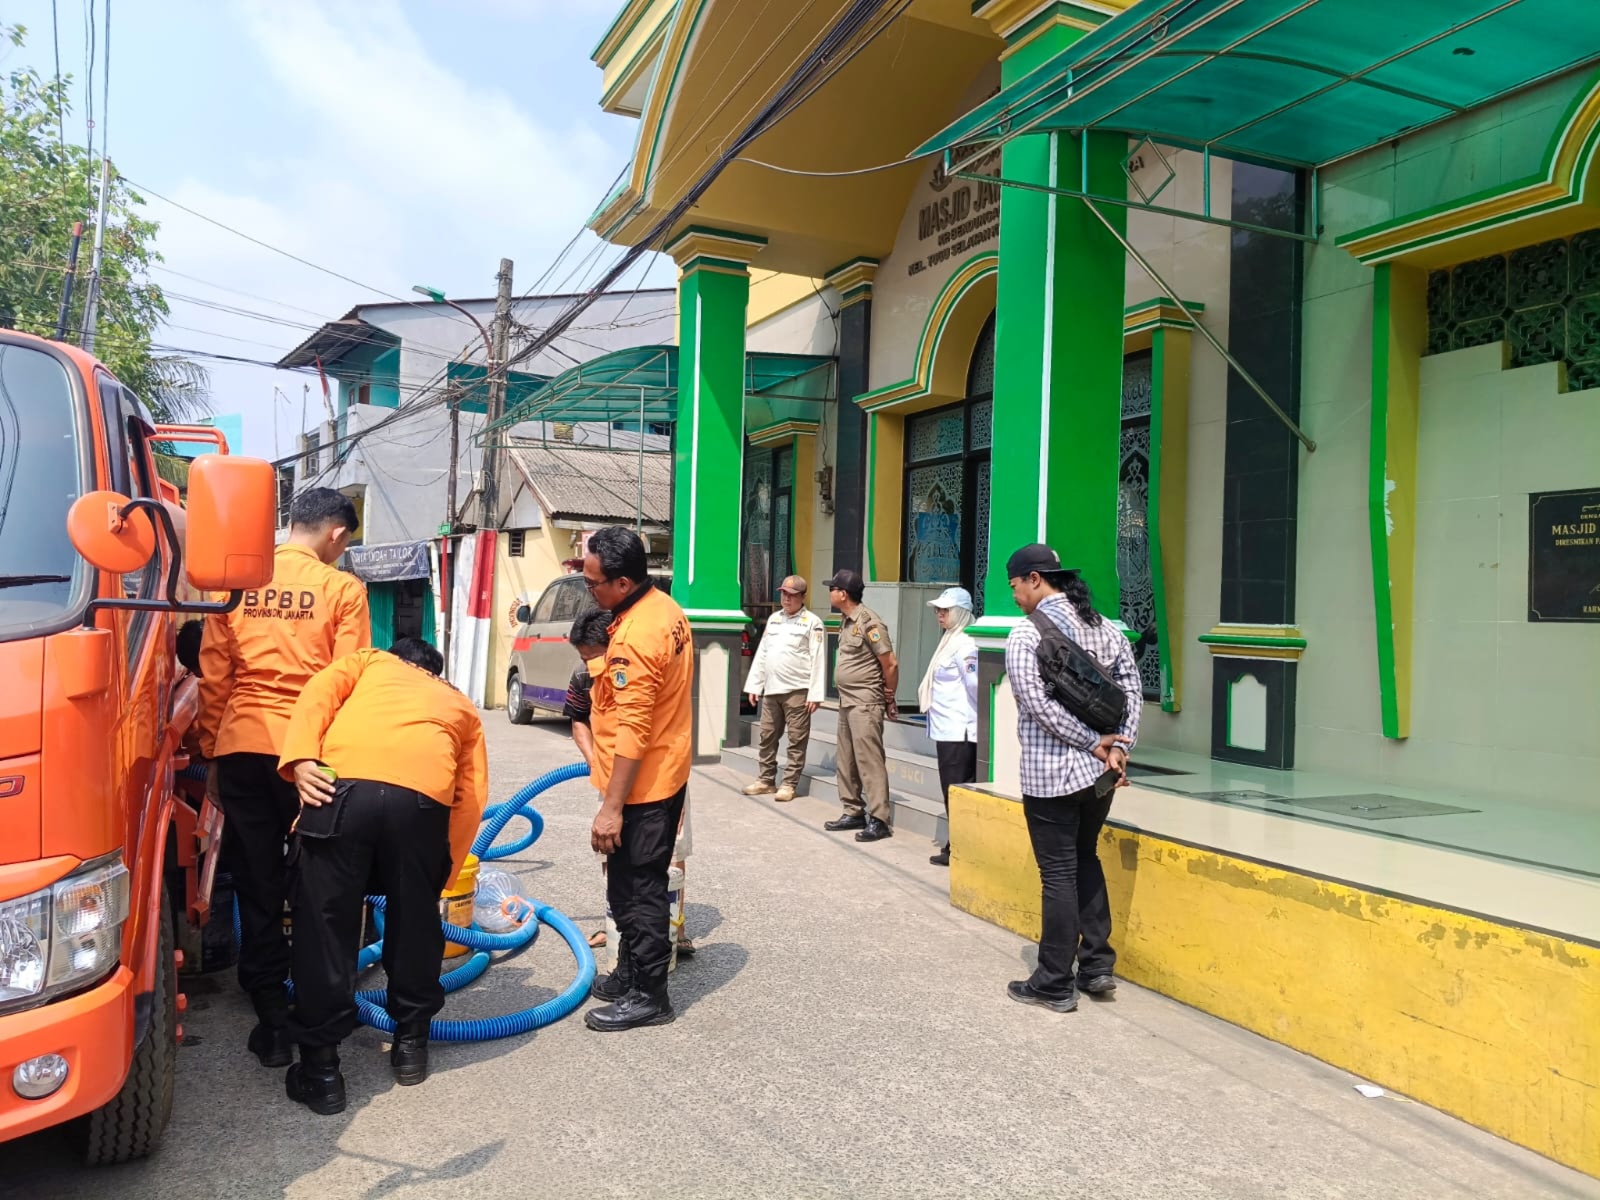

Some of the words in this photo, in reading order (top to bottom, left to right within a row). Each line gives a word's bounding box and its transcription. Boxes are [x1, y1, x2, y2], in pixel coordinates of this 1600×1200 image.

[919, 187, 970, 240] MASJID
[1552, 523, 1596, 535] MASJID
[245, 589, 315, 609] BPBD
[284, 611, 314, 620] JAKARTA
